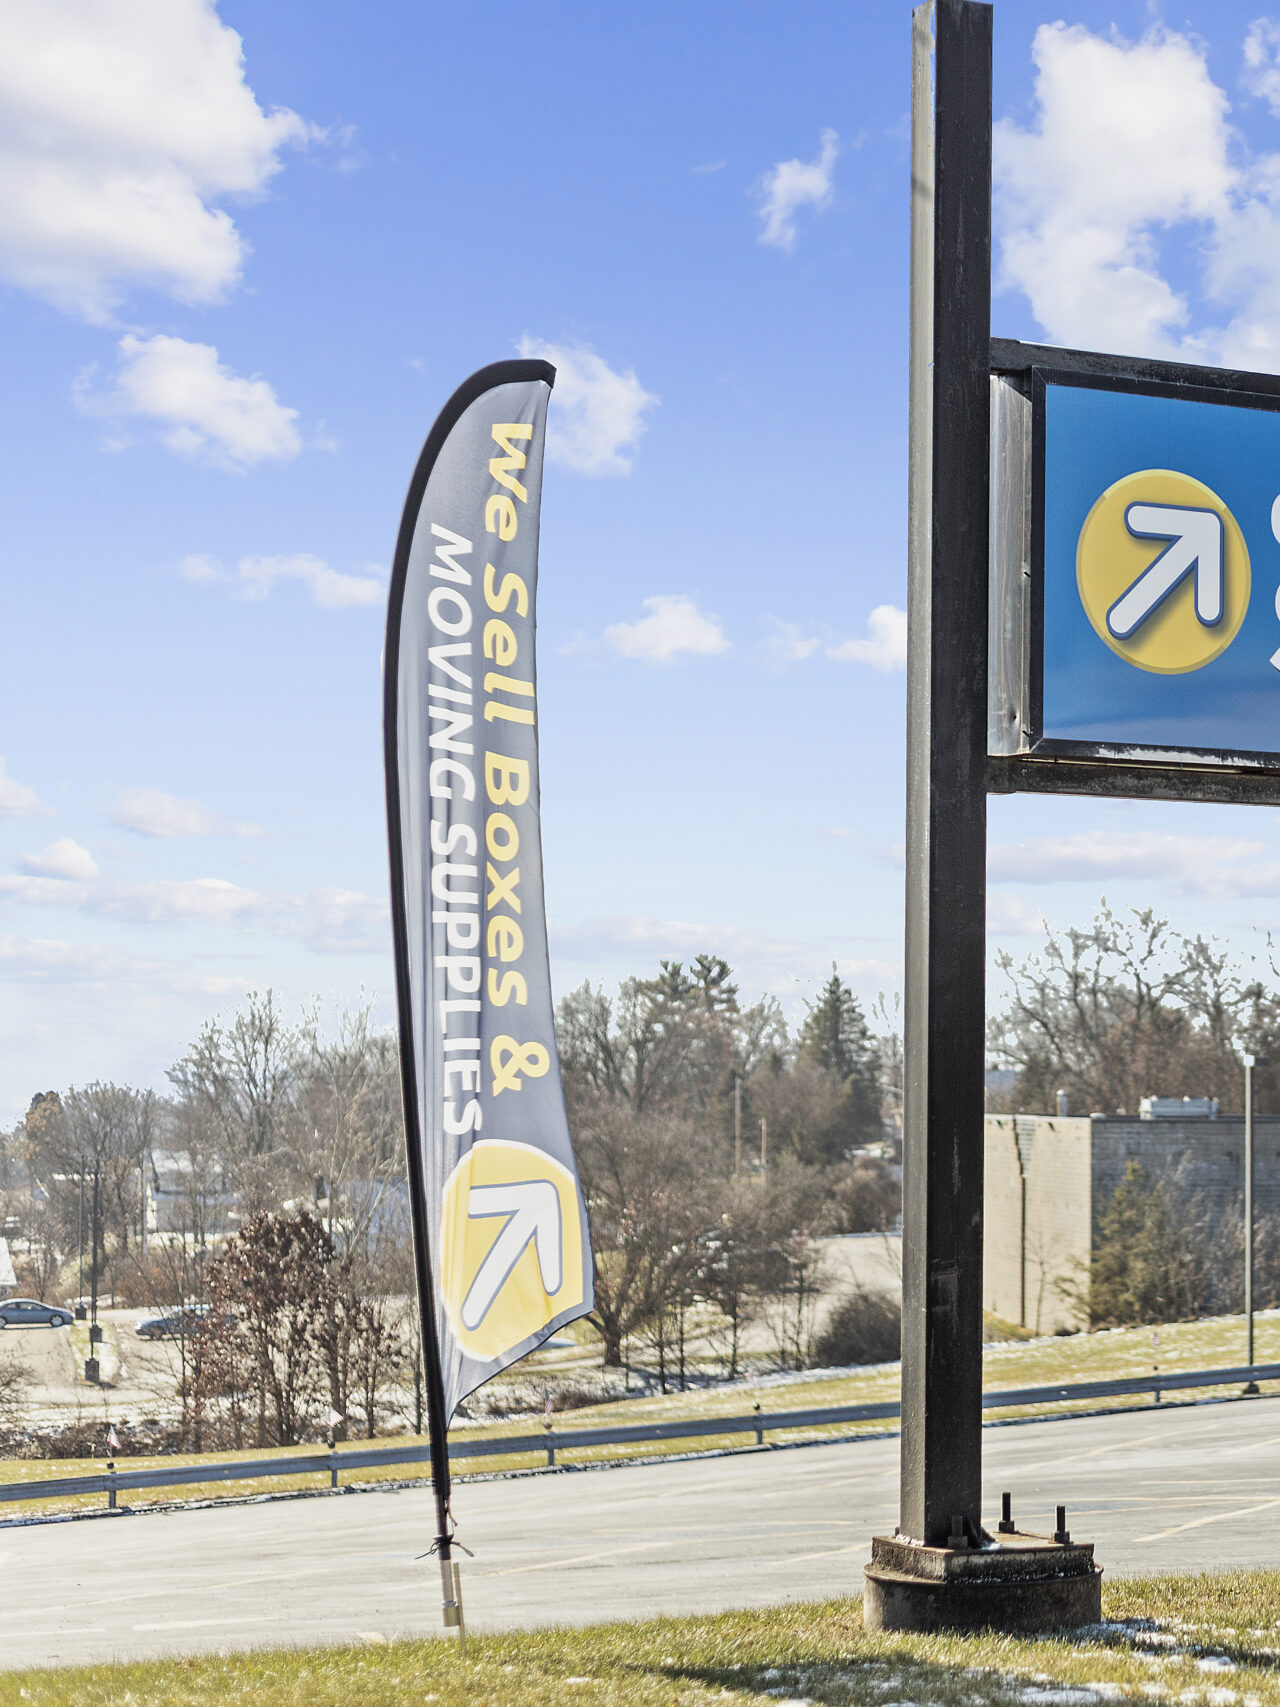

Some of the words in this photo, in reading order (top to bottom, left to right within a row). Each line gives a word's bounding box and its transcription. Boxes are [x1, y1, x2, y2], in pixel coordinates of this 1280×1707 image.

[484, 422, 533, 542] We
[427, 522, 476, 802] MOVING
[482, 562, 536, 726] Sell
[430, 819, 483, 1136] SUPPLIES
[484, 750, 531, 1008] Boxes
[489, 1034, 551, 1097] &
